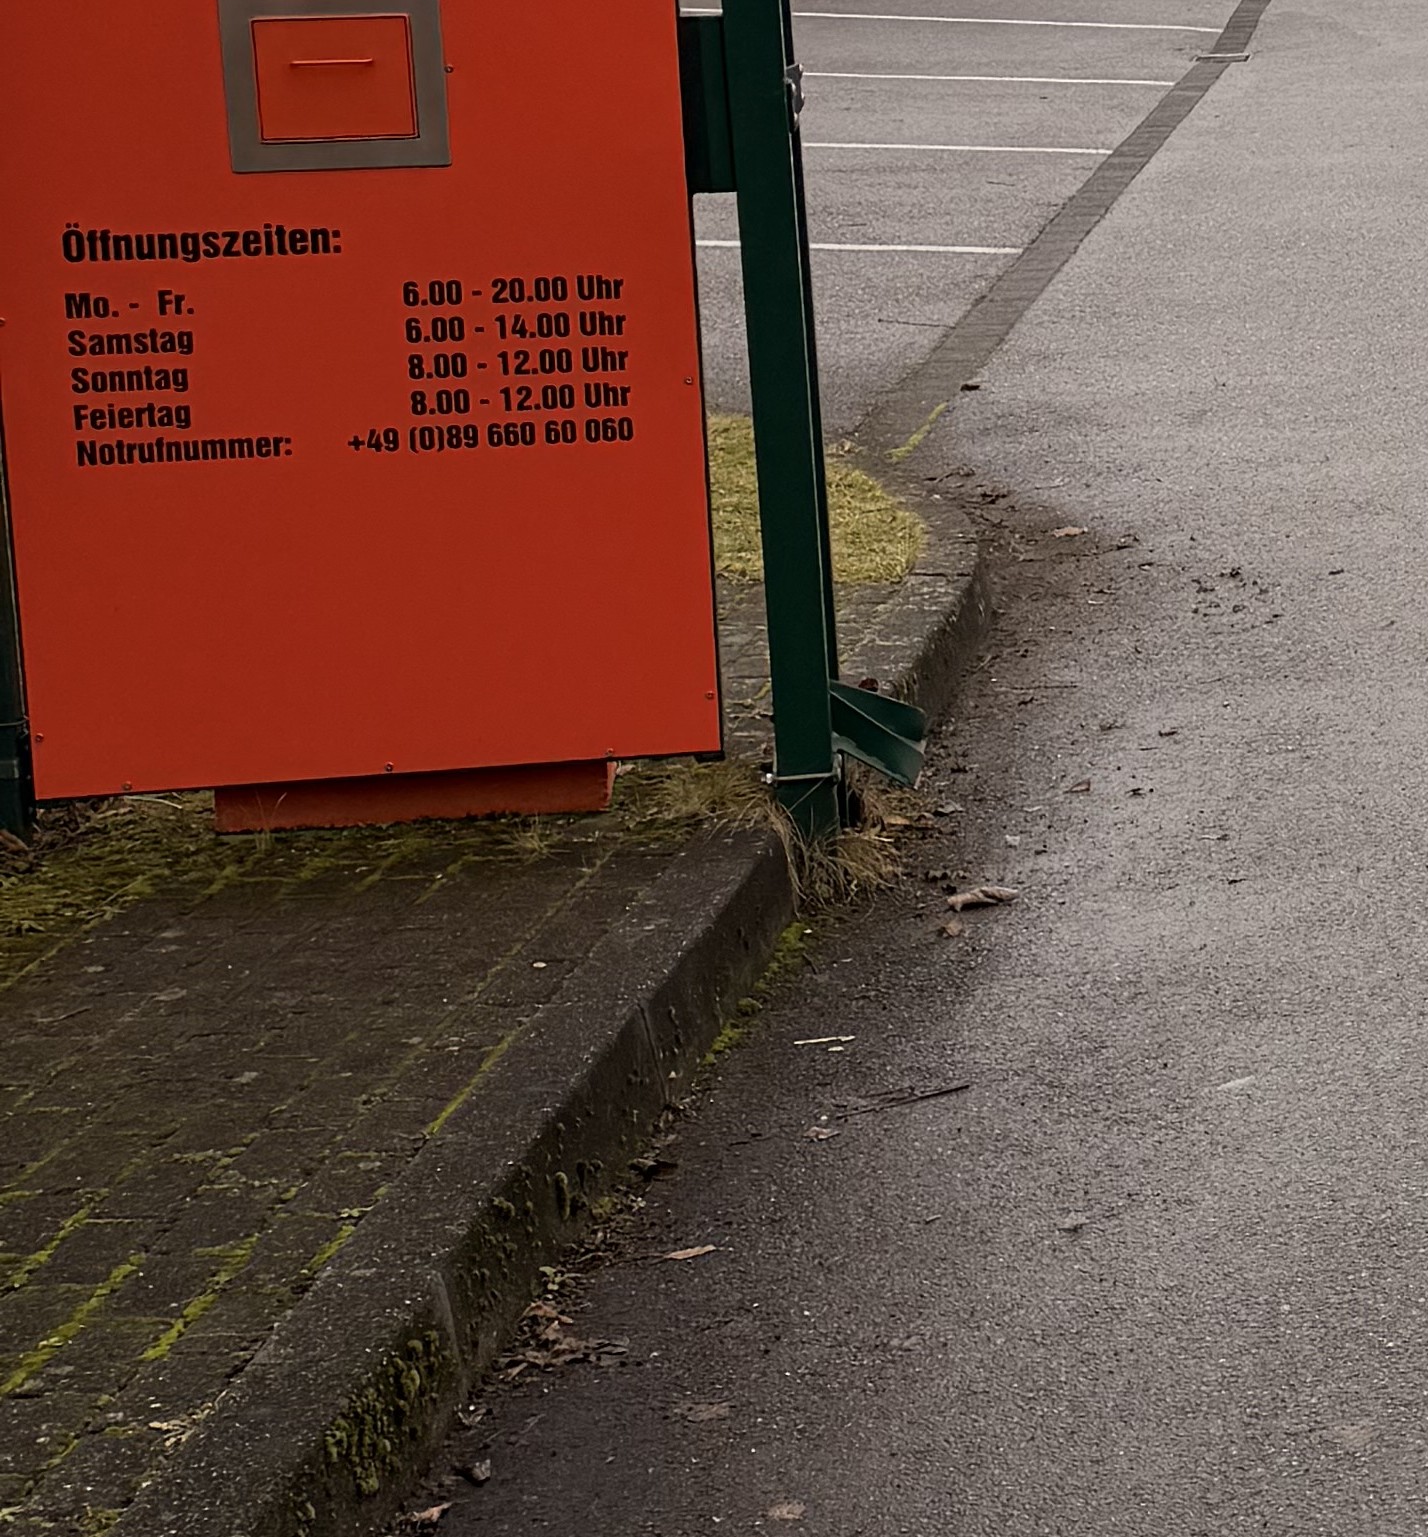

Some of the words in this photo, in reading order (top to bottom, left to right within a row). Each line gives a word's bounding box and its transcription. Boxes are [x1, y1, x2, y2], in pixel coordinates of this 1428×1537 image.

[62, 222, 341, 263] Öffnungszeiten:
[65, 292, 119, 319] Mo.
[157, 289, 194, 316] Fr.
[402, 279, 463, 307] 6.00
[491, 276, 568, 304] 20.00
[576, 274, 624, 301] Uhr
[67, 328, 194, 357] Samstag
[405, 316, 465, 344] 6.00
[494, 312, 571, 340] 14.00
[579, 310, 626, 337] Uhr
[71, 366, 189, 394] Sonntag
[407, 352, 468, 380] 8.00
[497, 348, 573, 376] 12.00
[581, 346, 628, 373] Uhr
[73, 401, 191, 431] Feiertag
[410, 388, 470, 416] 8.00
[499, 384, 575, 412] 12.00
[584, 382, 631, 409] Uhr
[76, 435, 291, 467] Notrufnummer:
[348, 427, 399, 453] +49
[409, 424, 479, 453] (0)89
[487, 421, 536, 448] 660
[544, 419, 577, 445] 60
[585, 416, 634, 443] 060
